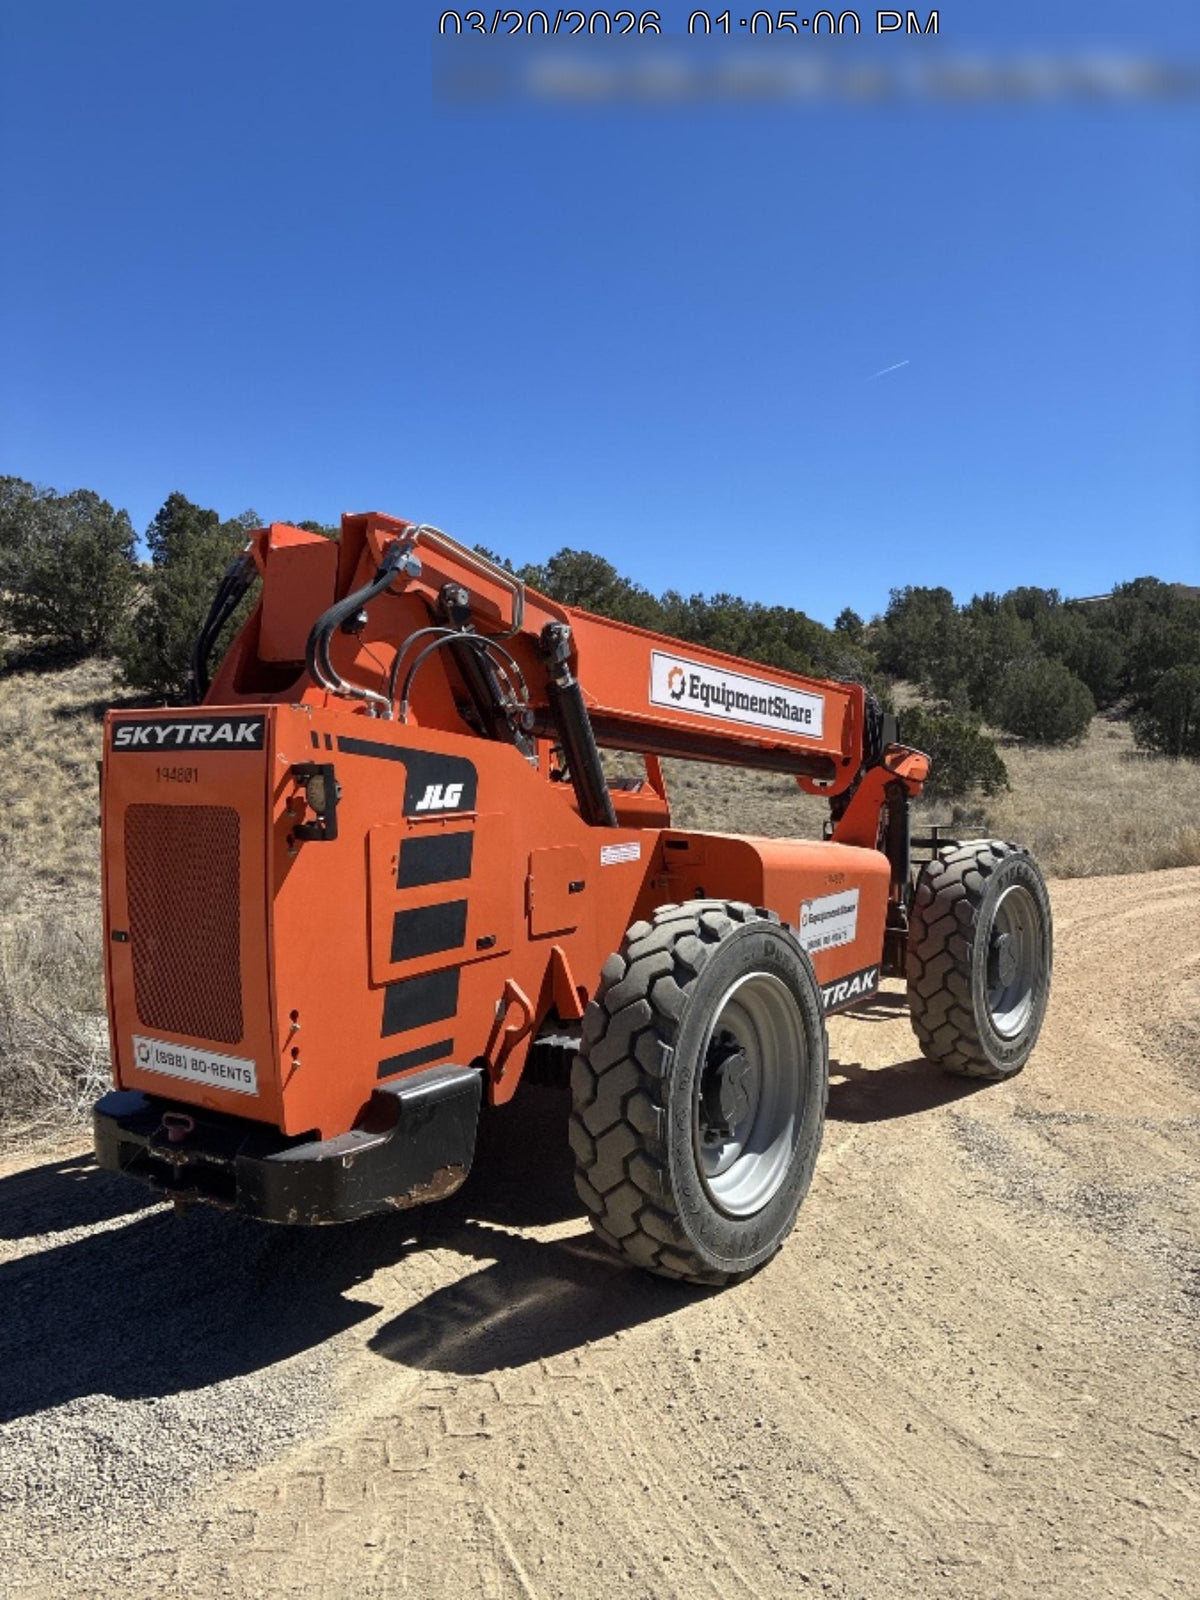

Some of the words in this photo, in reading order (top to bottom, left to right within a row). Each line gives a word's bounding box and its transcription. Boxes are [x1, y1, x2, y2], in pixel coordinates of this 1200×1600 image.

[688, 673, 812, 725] EquipmentShare
[114, 722, 261, 746] SKYTRAK
[416, 783, 464, 811] JLG
[820, 968, 878, 1009] TRAK
[155, 1048, 188, 1070] (888)
[191, 1058, 252, 1084] 80-RENTS
